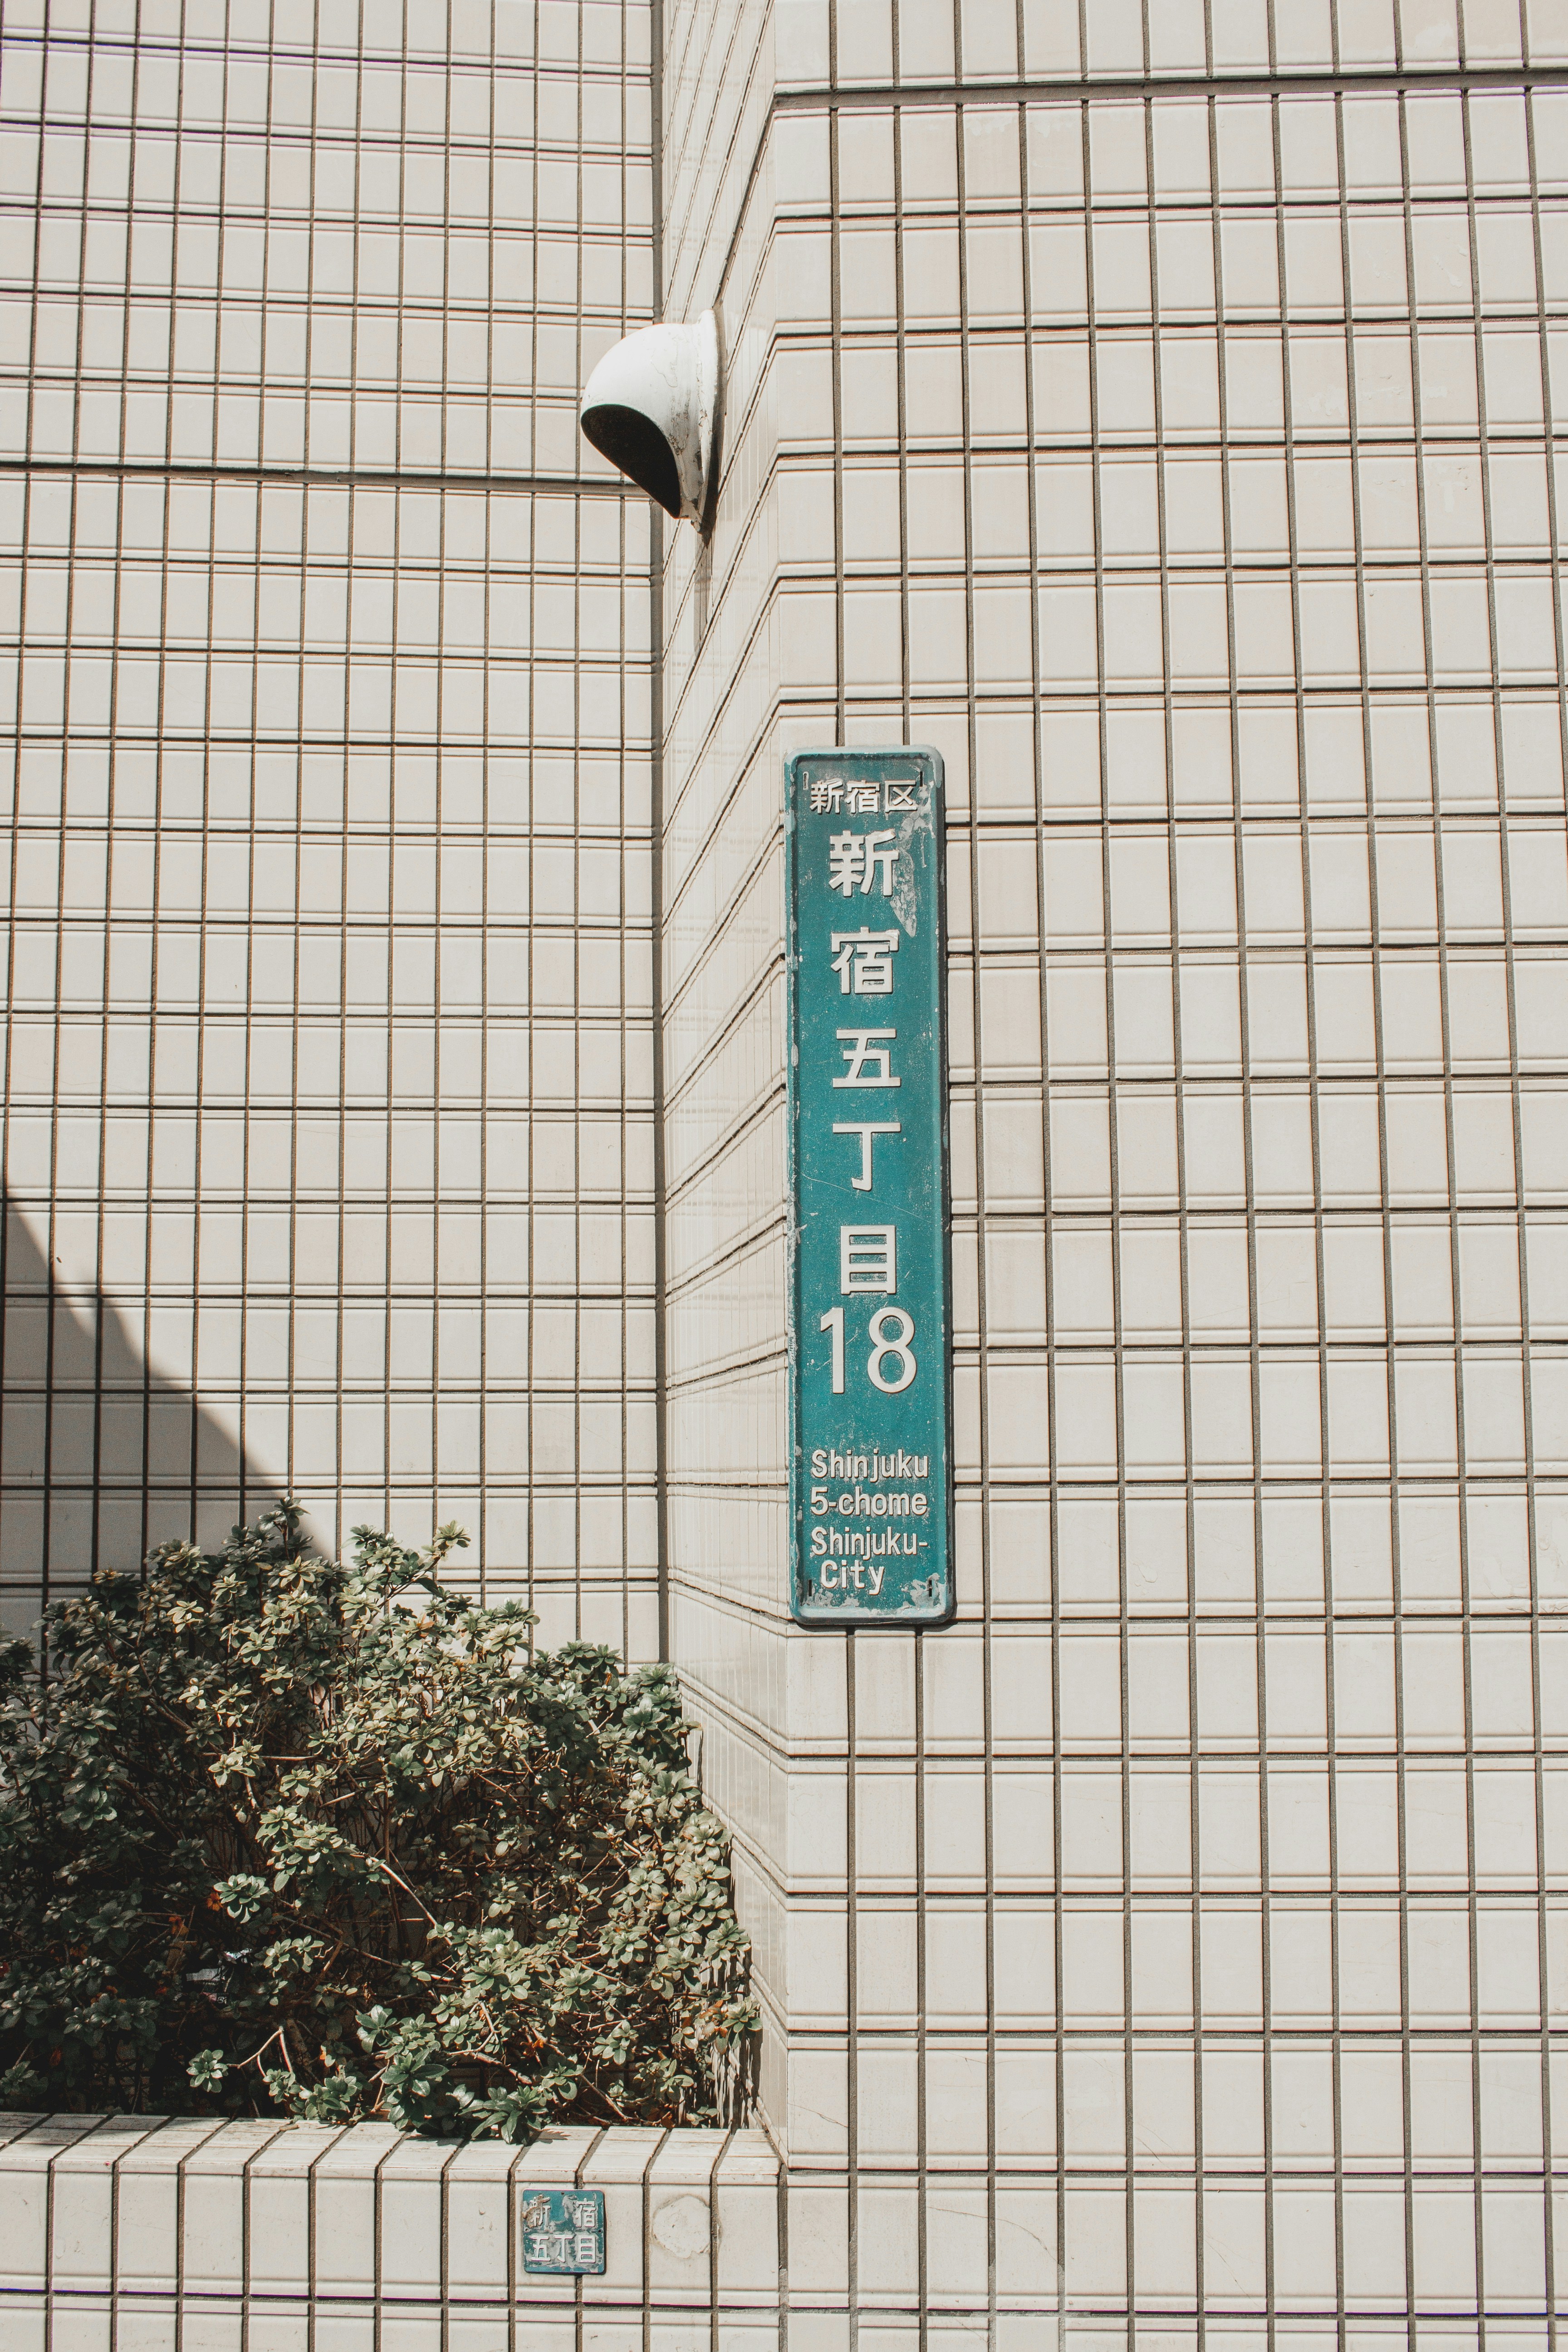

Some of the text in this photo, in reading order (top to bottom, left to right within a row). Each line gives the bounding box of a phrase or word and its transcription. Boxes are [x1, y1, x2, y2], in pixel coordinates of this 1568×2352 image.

[809, 778, 918, 814] 新宿区
[828, 828, 902, 1295] 新宿五丁目
[820, 1307, 917, 1394] 18
[811, 1449, 929, 1483] Shinjuku
[810, 1486, 928, 1516] 5-chome
[811, 1526, 928, 1560] Shinjuku-
[820, 1559, 885, 1595] City
[529, 2234, 596, 2264] 五丁目
